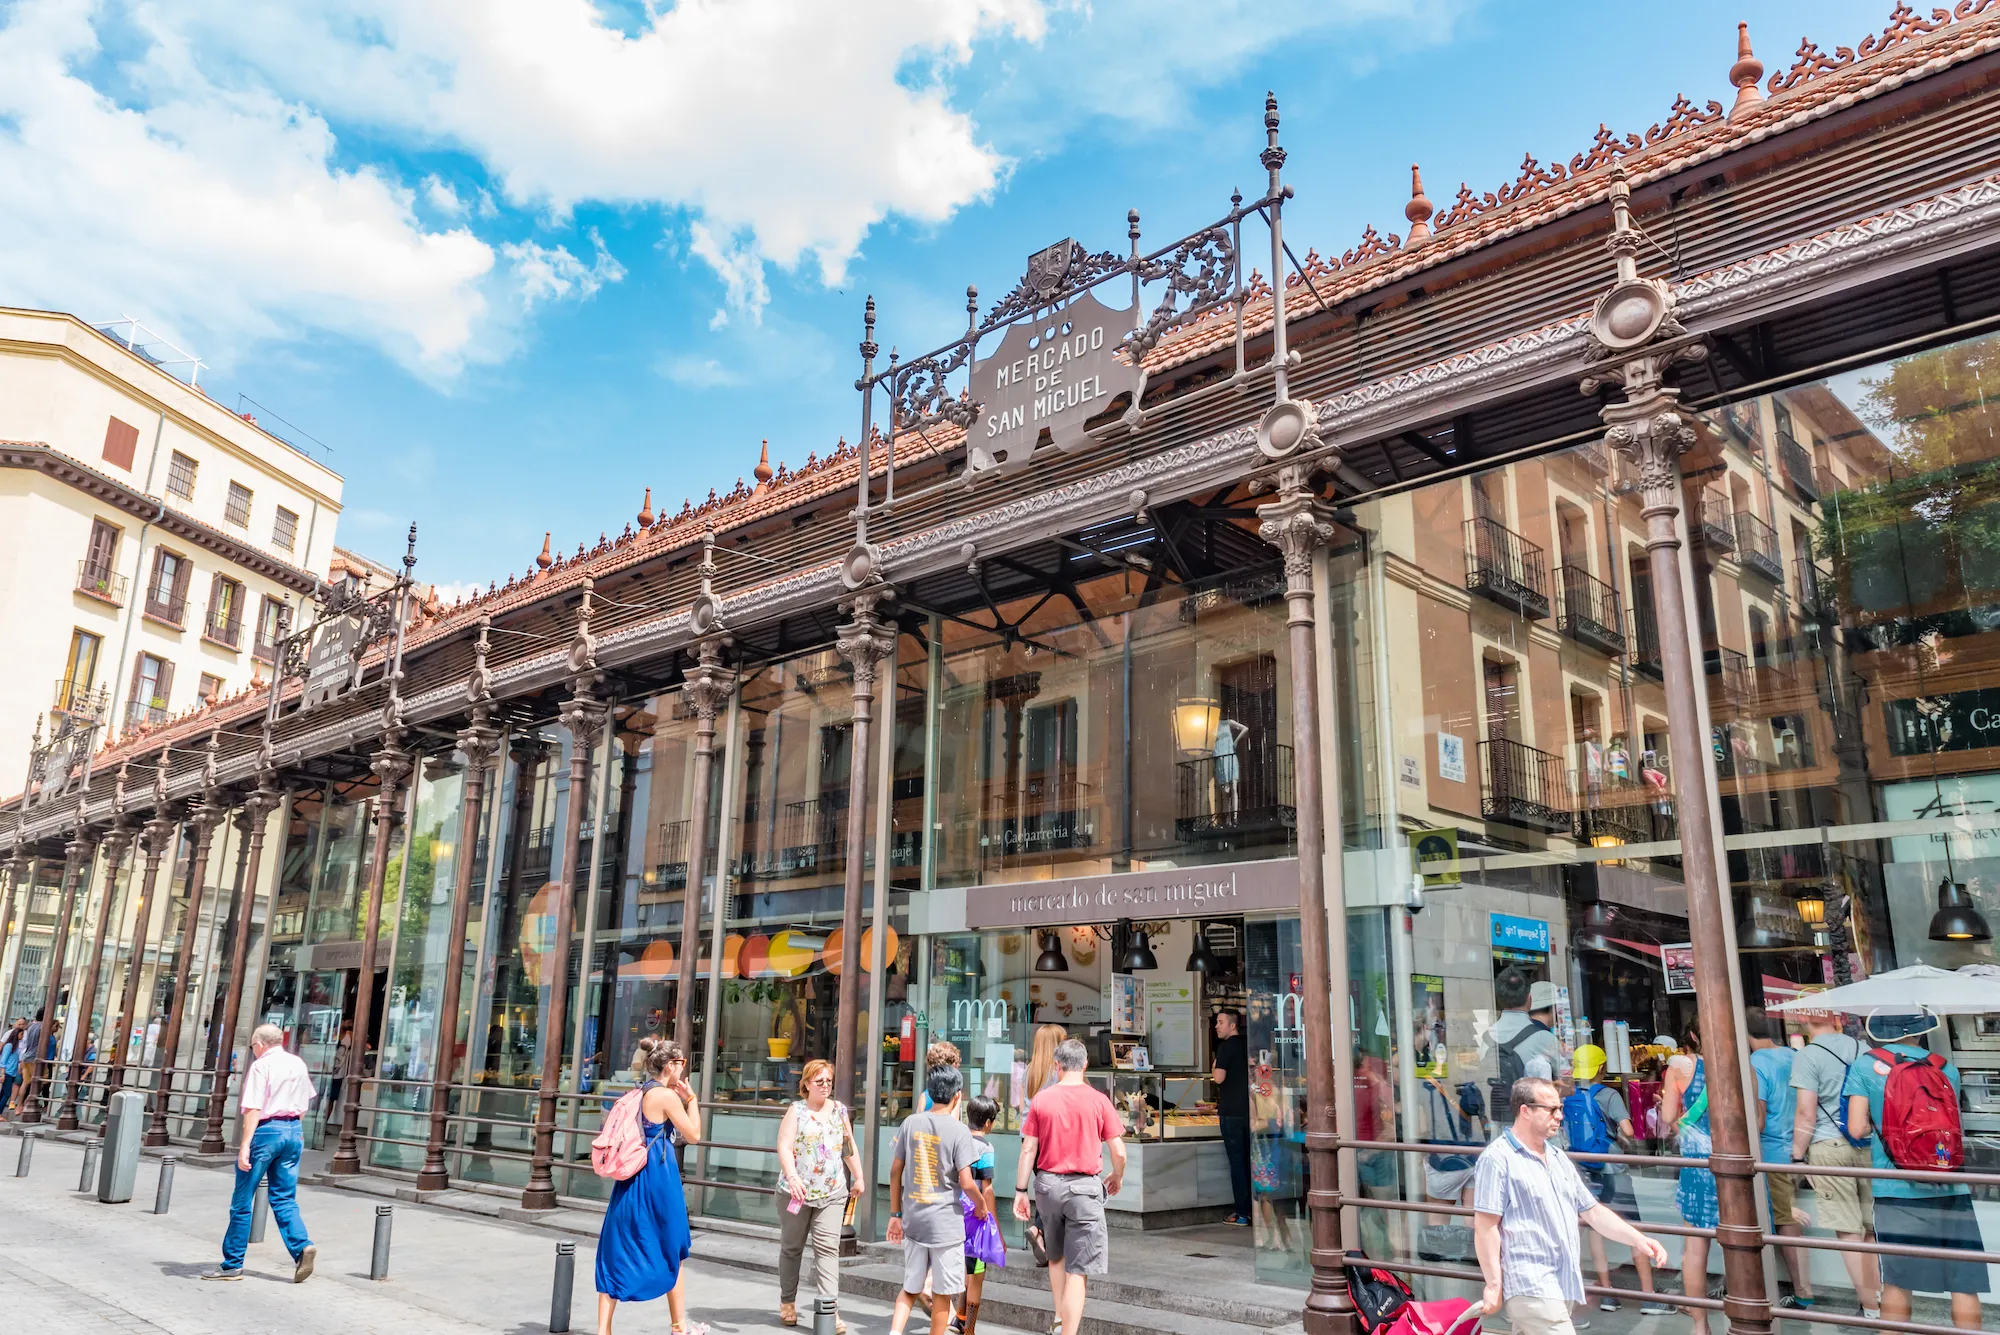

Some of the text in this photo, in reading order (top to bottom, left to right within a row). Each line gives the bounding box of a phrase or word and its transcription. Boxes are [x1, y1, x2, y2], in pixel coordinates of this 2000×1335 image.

[997, 326, 1104, 389] MERCADO
[1035, 369, 1063, 393] DE
[987, 375, 1108, 438] SAN MIGUEL
[1010, 872, 1238, 913] mercado de san miguel
